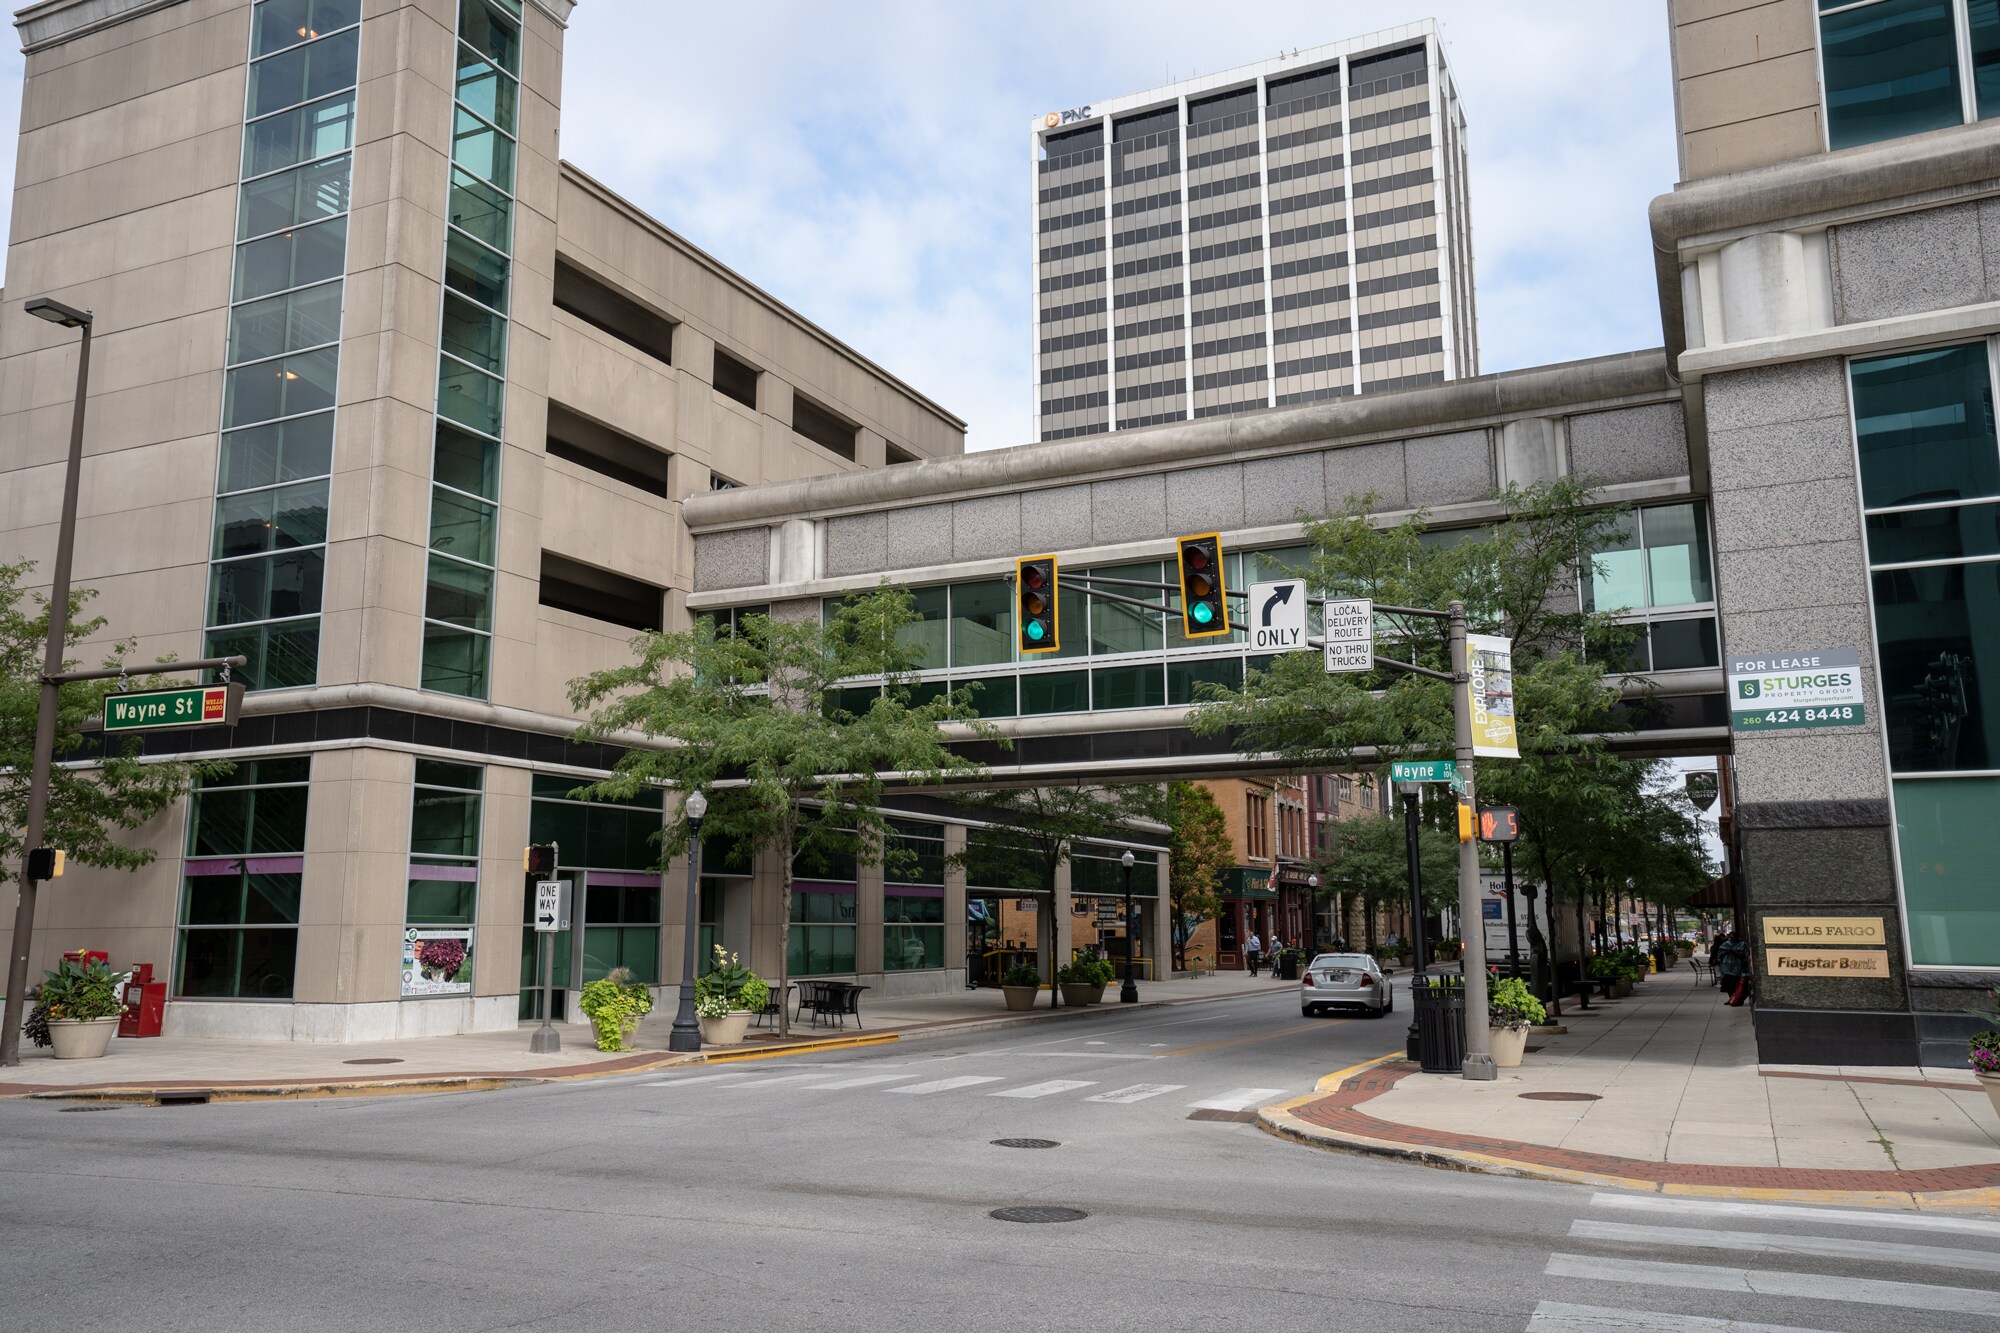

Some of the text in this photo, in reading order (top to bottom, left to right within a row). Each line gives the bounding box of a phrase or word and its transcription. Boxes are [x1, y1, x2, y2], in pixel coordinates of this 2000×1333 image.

[1061, 105, 1091, 124] PNC
[1334, 605, 1362, 616] LOCAL
[1328, 616, 1369, 627] DELIVERY
[1257, 628, 1300, 647] ONLY
[1335, 628, 1363, 638] ROUTE
[1329, 644, 1369, 655] NO THRU
[1332, 655, 1367, 666] TRUCKS
[1735, 656, 1821, 672] FOR LEASE
[1763, 673, 1852, 691] STURGES
[1472, 659, 1488, 725] EXPLORE
[1765, 690, 1814, 698] PROPERTY
[1793, 694, 1854, 703] SturgesProperty.com
[115, 697, 194, 722] Wayne St
[1743, 707, 1853, 725] 260 424 8448
[1394, 764, 1434, 779] Wayne
[1507, 813, 1518, 835] 5
[540, 885, 557, 897] ONE
[1490, 881, 1523, 890] Holln
[539, 899, 557, 910] WAY
[1772, 926, 1875, 936] WELLS FARGO
[1777, 956, 1877, 971] Flagstar Bank
